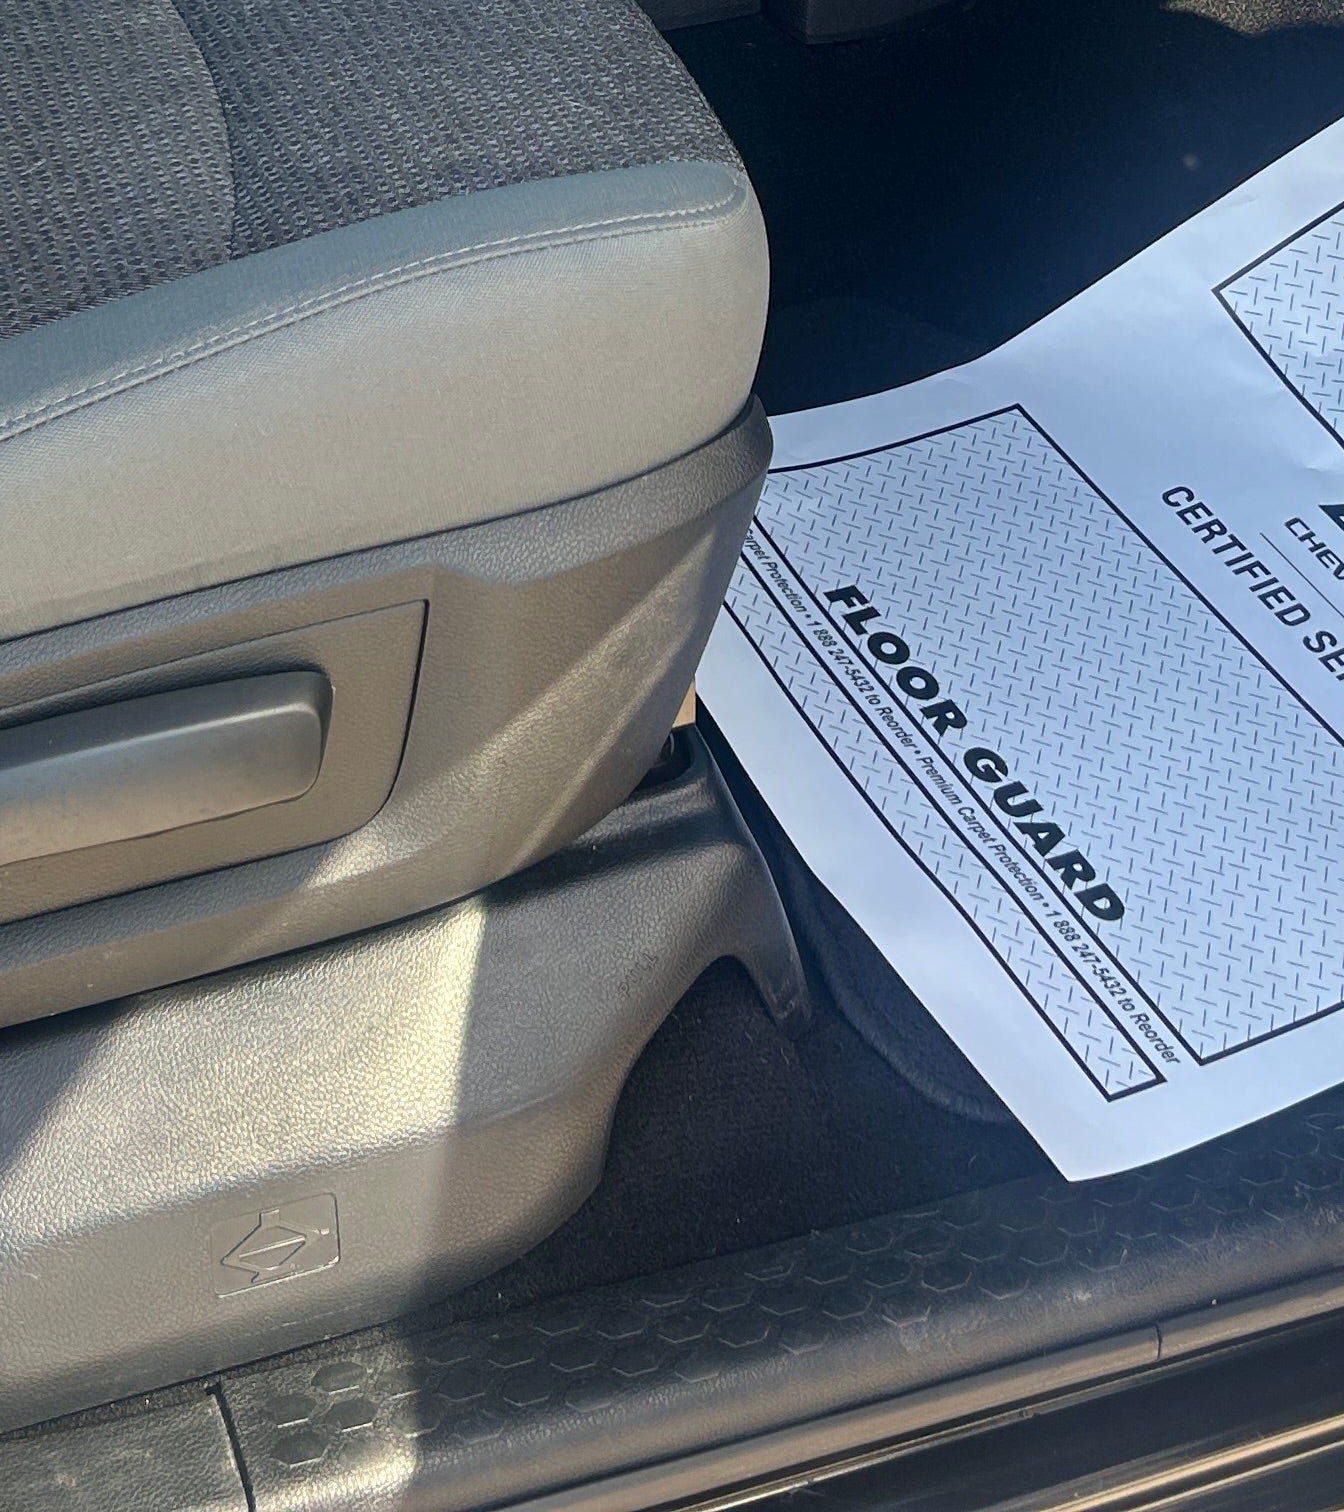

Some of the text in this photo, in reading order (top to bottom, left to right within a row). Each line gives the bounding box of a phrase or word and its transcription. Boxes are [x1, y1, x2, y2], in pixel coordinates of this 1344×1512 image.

[1161, 486, 1311, 627] CERTIFIED
[761, 561, 807, 612] Protection
[807, 618, 822, 627] 1
[813, 629, 837, 647] 888
[827, 648, 875, 693] 247-5432
[864, 694, 881, 705] to
[875, 706, 918, 748] Reorder
[823, 584, 1125, 921] FLOOR GUARD
[915, 756, 962, 805] Premium
[957, 807, 997, 843] Carpet
[988, 844, 1044, 900] Protection
[1045, 910, 1062, 918] 1
[1053, 920, 1081, 942] 888
[1071, 943, 1127, 998] 247-5432
[1117, 997, 1135, 1011] to
[1130, 1012, 1181, 1065] Reorder
